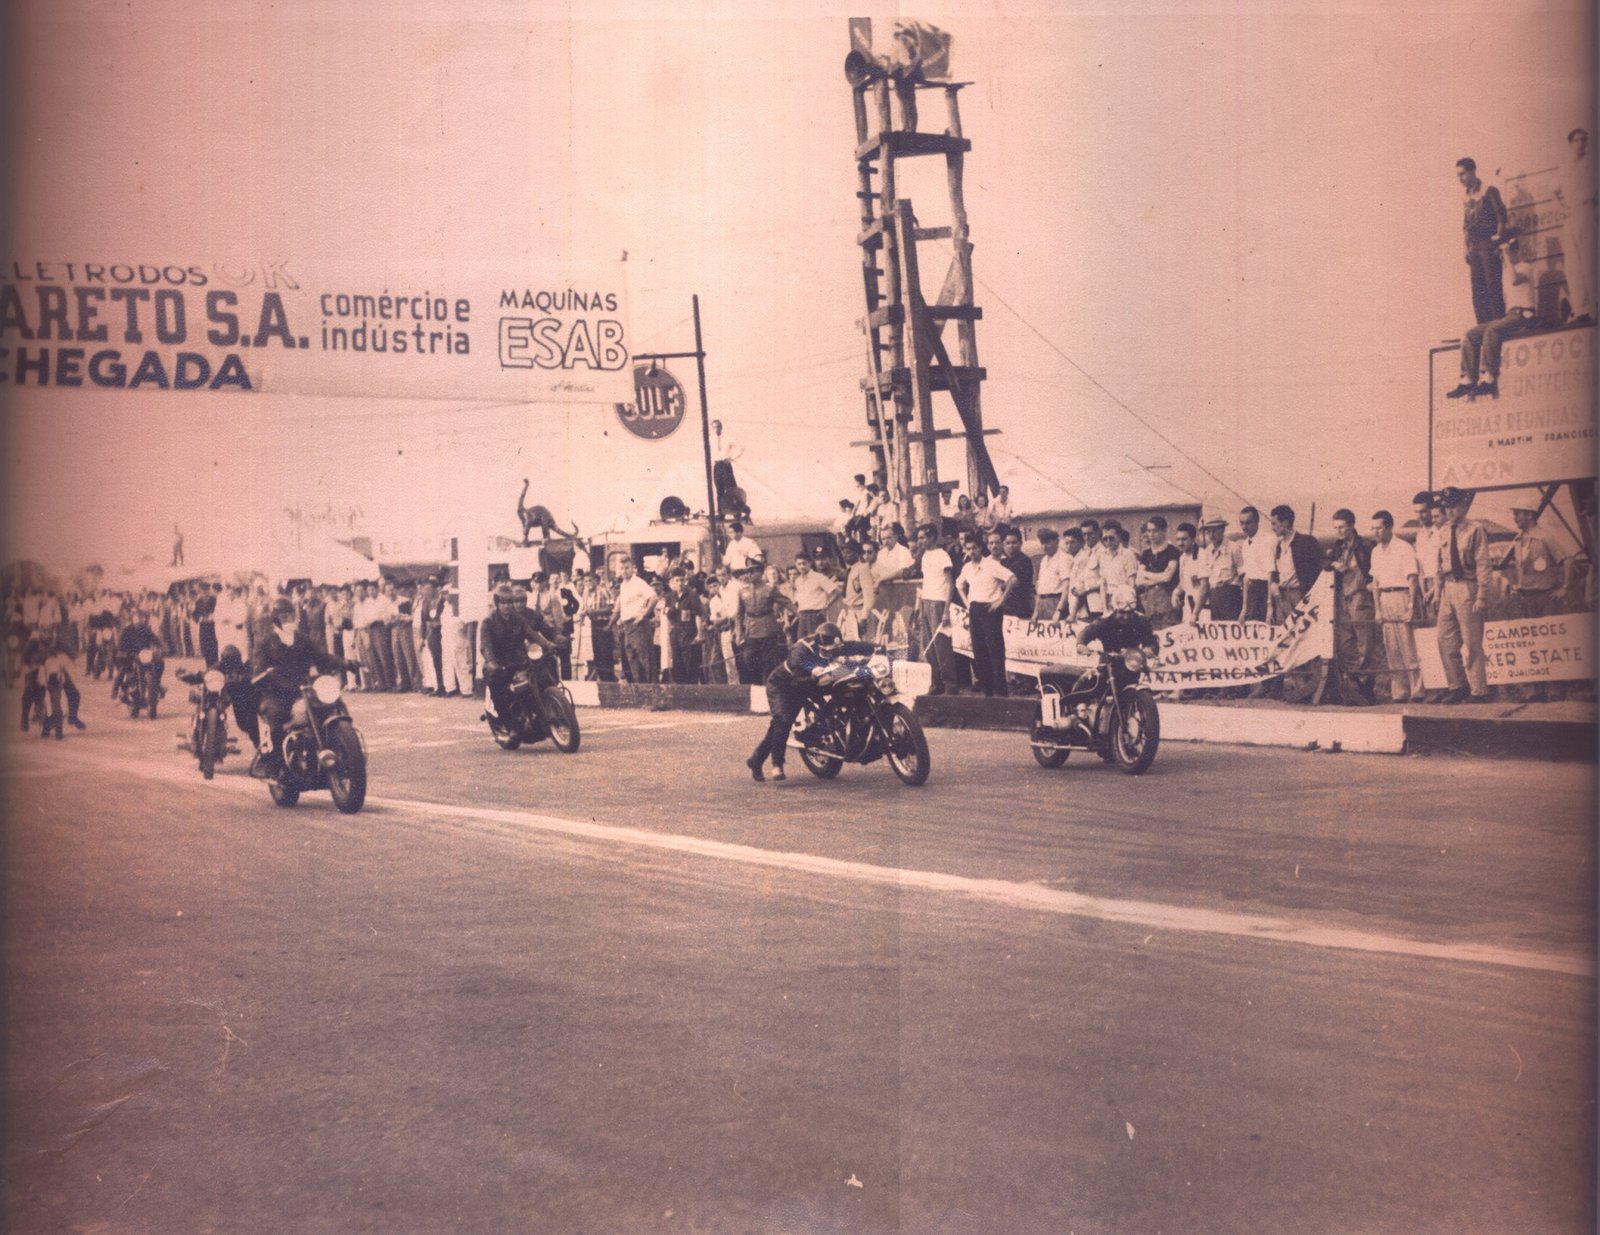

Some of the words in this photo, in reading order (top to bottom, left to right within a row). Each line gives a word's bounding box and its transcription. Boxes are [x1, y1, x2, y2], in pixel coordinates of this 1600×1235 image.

[206, 289, 310, 349] S.A.
[320, 289, 448, 322] comércio
[455, 298, 470, 322] e
[320, 320, 471, 354] indústria
[498, 317, 628, 371] ESAB
[0, 346, 252, 390] HEGADA
[1442, 459, 1514, 484] AVON
[1026, 621, 1077, 638] PROVA
[1529, 647, 1582, 665] STATE
